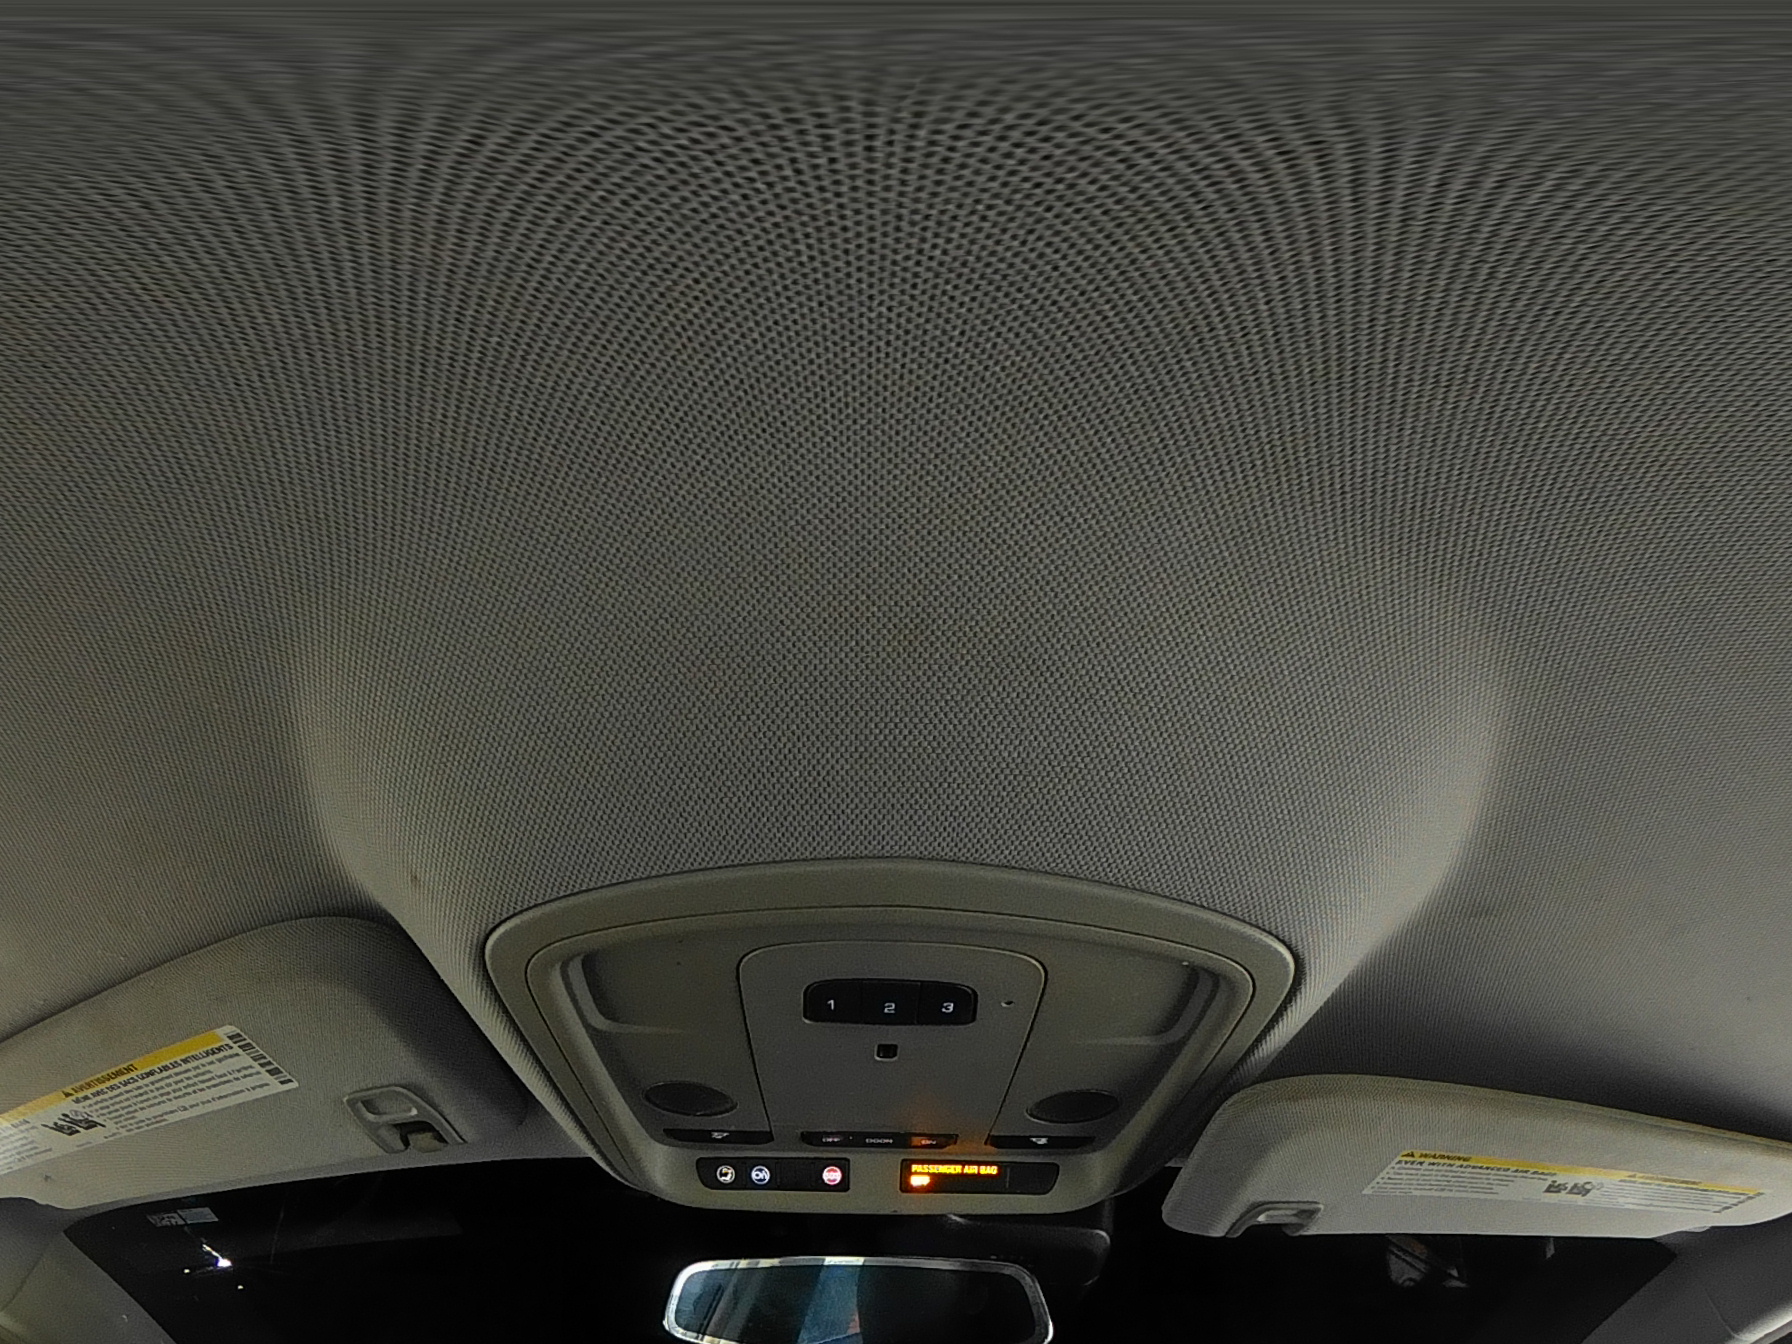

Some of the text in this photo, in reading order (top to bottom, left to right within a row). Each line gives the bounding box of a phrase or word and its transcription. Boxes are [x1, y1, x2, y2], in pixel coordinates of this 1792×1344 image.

[827, 999, 835, 1011] 1
[883, 1002, 896, 1014] 2
[941, 1002, 954, 1013] 3
[71, 1063, 138, 1094] AVERTISSEMENT
[1418, 1152, 1472, 1162] WARNING
[911, 1164, 998, 1175] PASSENGER AIR BAG
